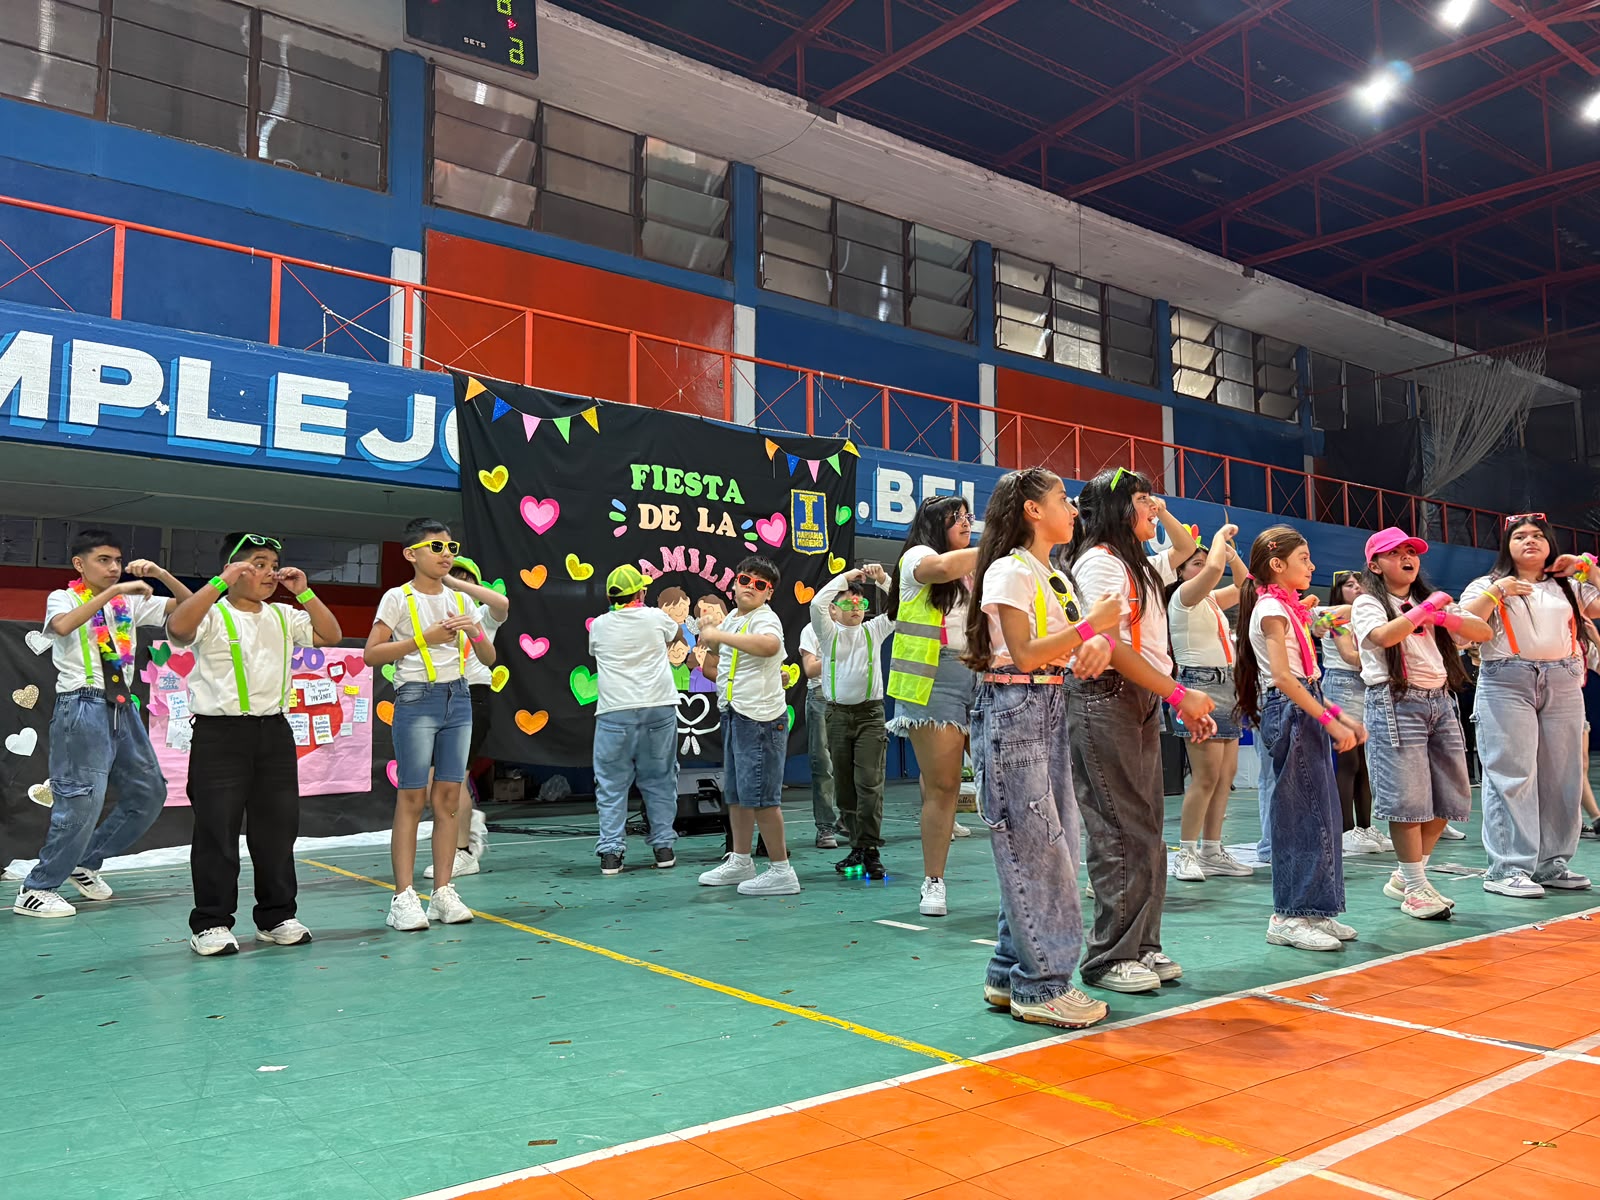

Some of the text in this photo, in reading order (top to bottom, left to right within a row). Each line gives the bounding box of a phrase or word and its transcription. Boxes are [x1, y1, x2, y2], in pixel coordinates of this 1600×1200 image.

[463, 36, 486, 48] SETS
[0, 330, 462, 466] MPLEJ
[630, 464, 745, 504] FIESTA
[637, 503, 737, 537] DE LA
[637, 545, 735, 600] AMILI
